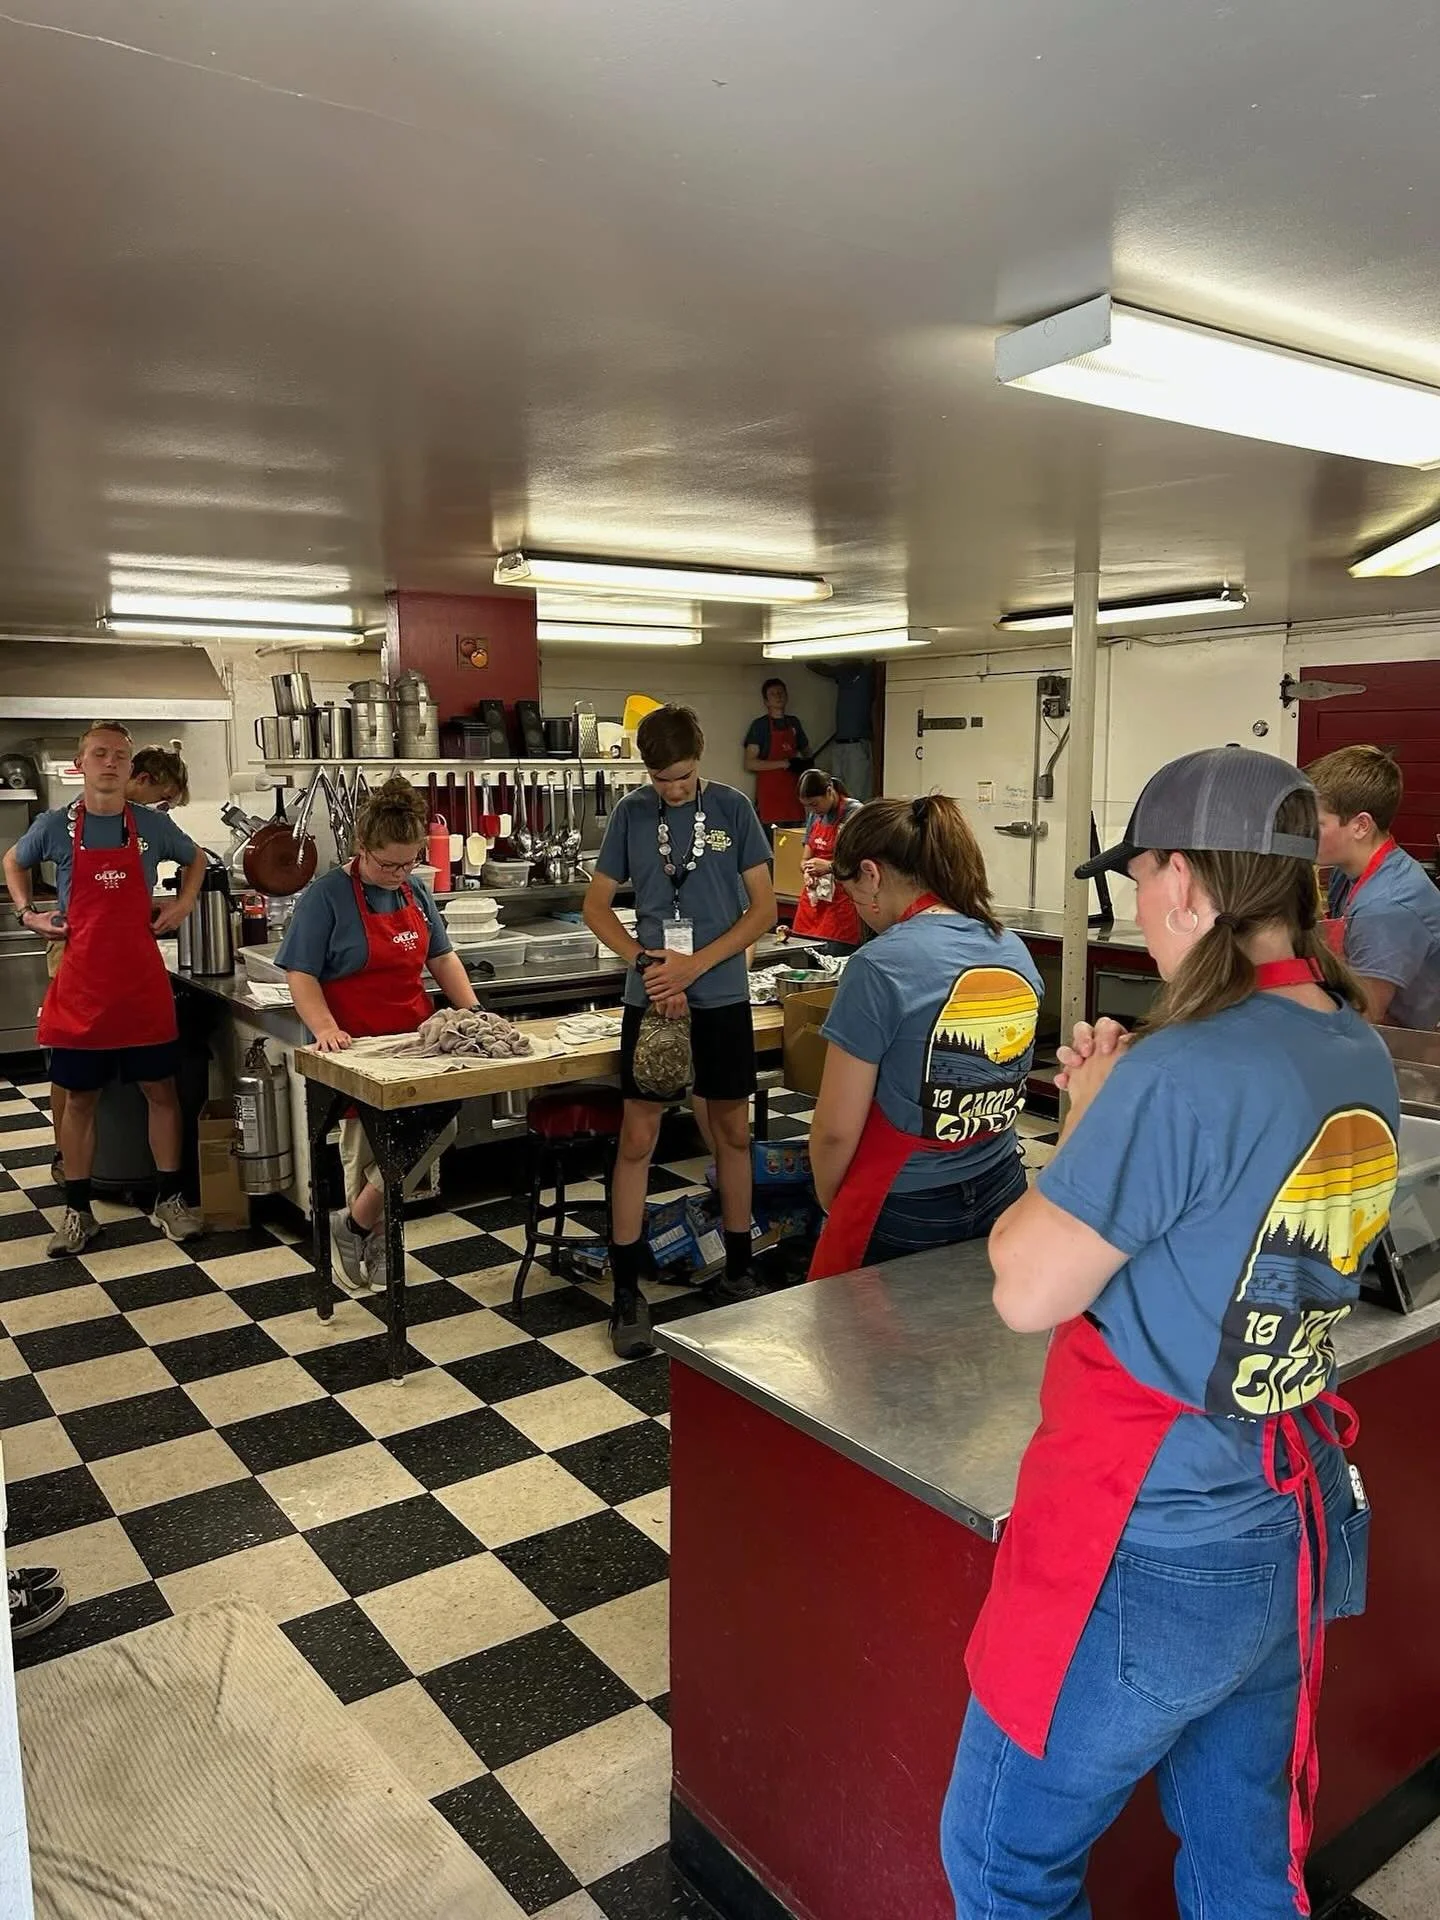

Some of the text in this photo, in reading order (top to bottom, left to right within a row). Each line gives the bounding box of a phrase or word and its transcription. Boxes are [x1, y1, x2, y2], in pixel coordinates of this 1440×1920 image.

[932, 1089, 952, 1108] 19
[959, 1088, 1014, 1118] CAMP
[1244, 1311, 1282, 1346] 19
